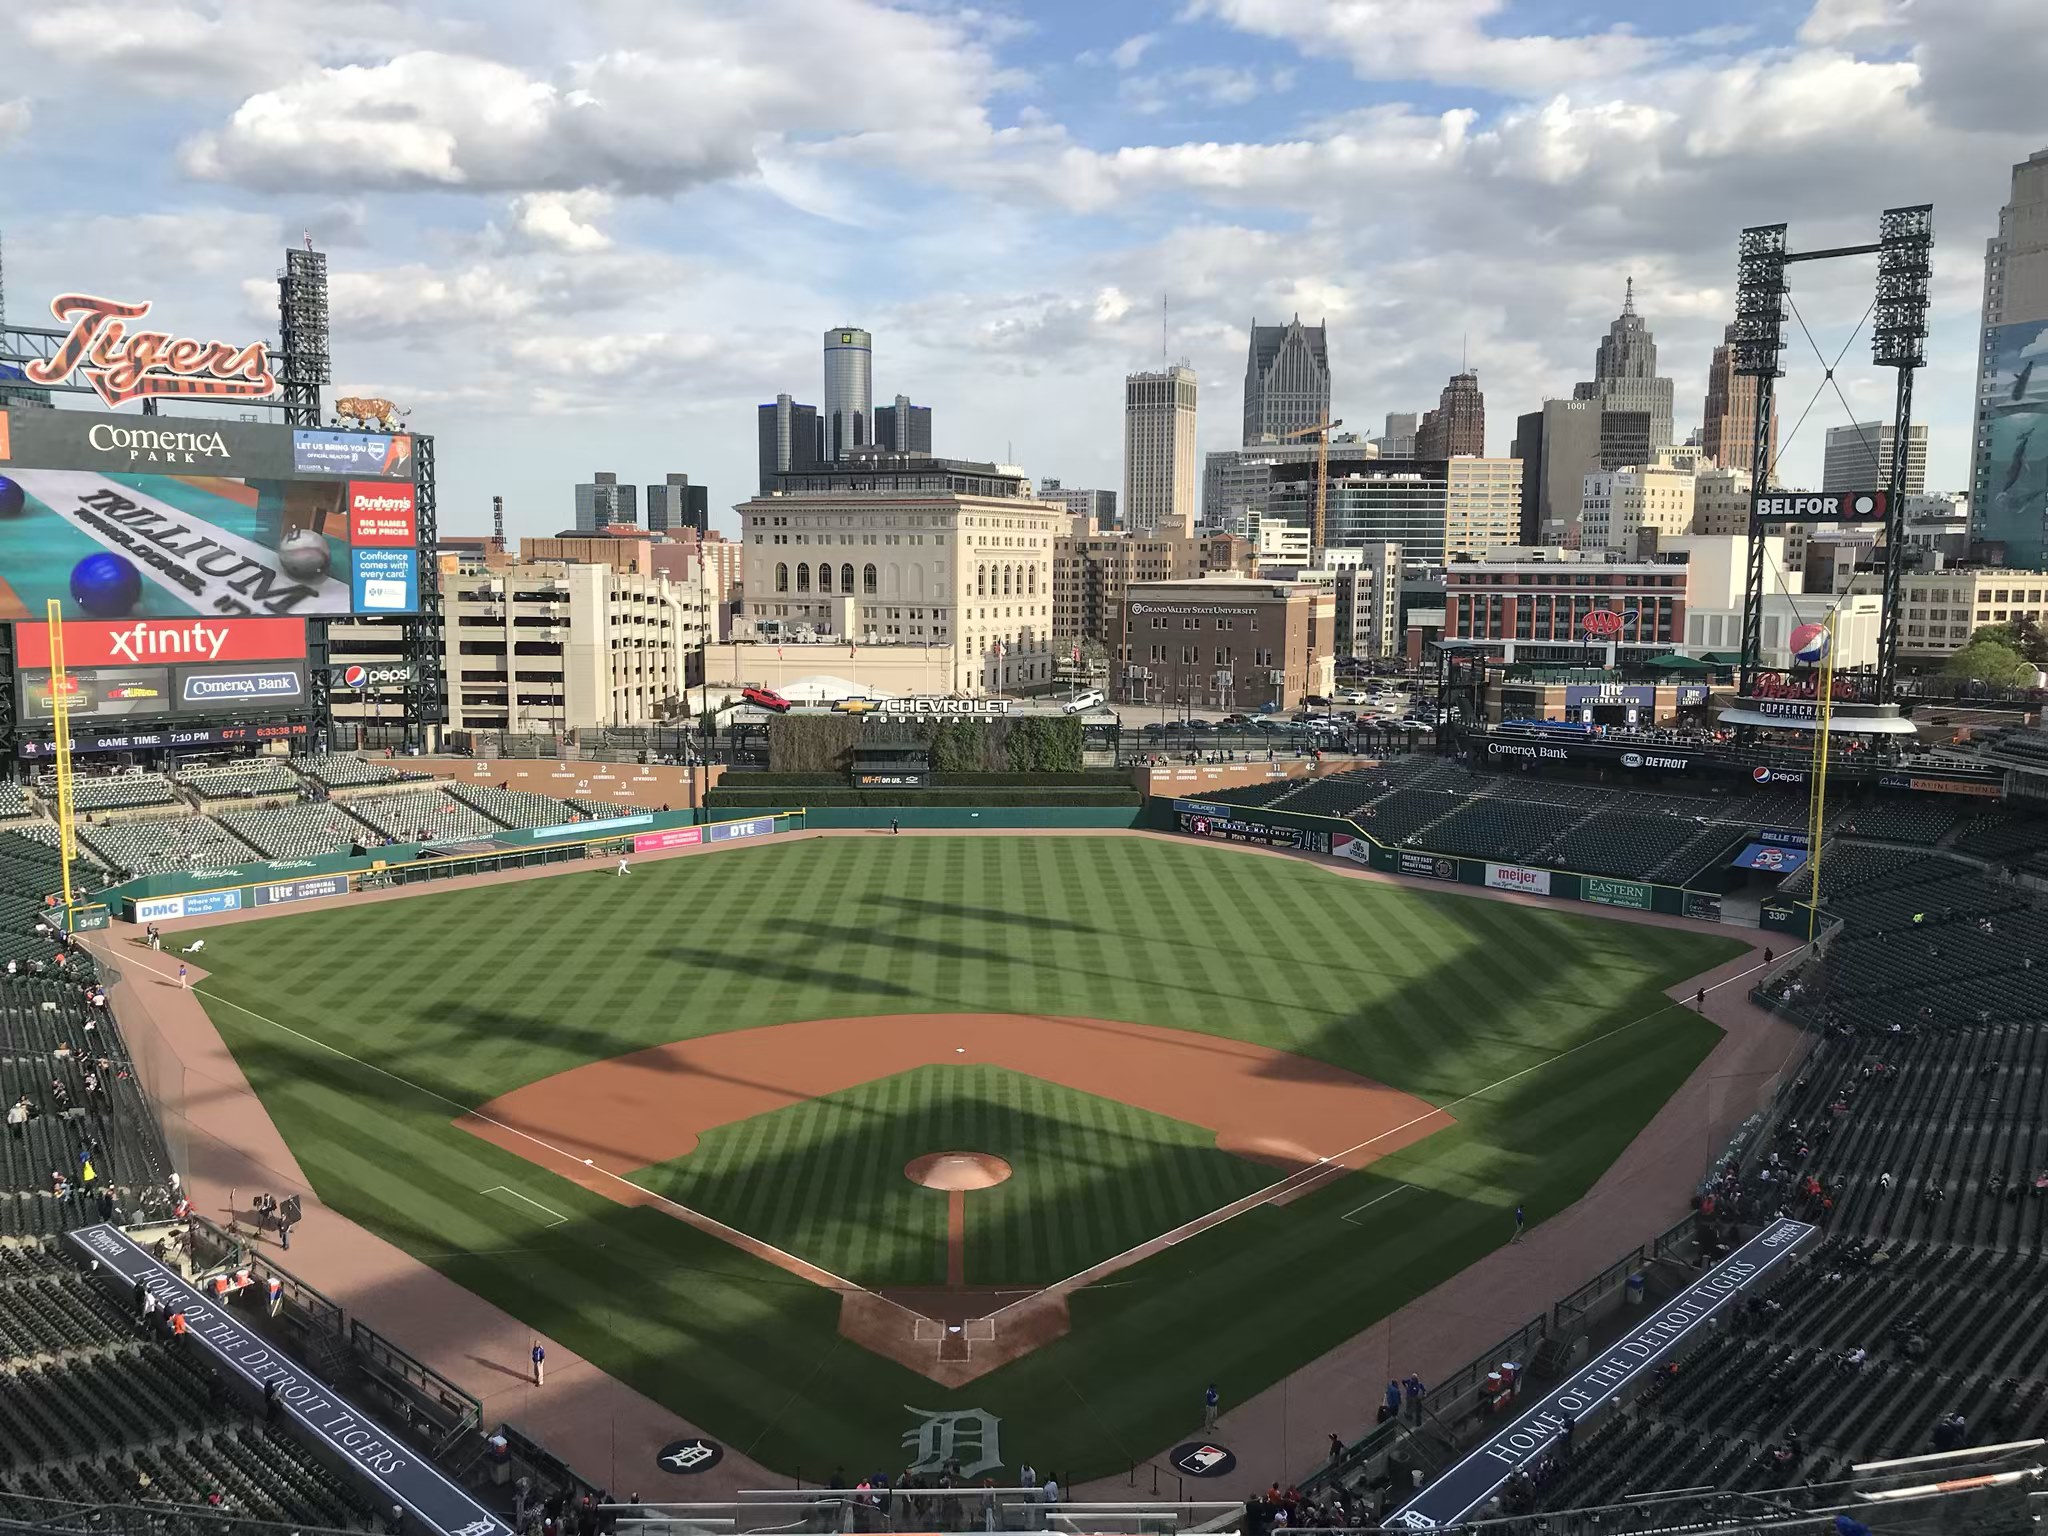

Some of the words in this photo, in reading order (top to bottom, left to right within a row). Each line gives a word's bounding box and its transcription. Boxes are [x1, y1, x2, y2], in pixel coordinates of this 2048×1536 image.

[25, 293, 275, 409] Tigers
[130, 450, 195, 463] PARK
[354, 495, 411, 510] Dunham's
[1757, 497, 1838, 515] BELFOR
[377, 520, 407, 528] NAMES
[379, 528, 409, 536] PRICES
[78, 488, 319, 614] TRILLIUM
[360, 551, 408, 560] Confidence
[390, 561, 408, 569] with
[360, 571, 384, 580] every
[1142, 605, 1167, 613] GRAND
[1167, 606, 1191, 614] VALLEY
[1586, 611, 1621, 632] AAA
[109, 621, 230, 661] xfinity
[369, 667, 410, 684] pepsi
[258, 678, 291, 690] Bank
[1600, 683, 1624, 698] Lite
[886, 699, 1013, 714] CHEVROLET
[862, 716, 993, 724] FOUNTAIN
[98, 738, 128, 747] GAME
[133, 736, 160, 745] TIME:
[170, 734, 191, 742] 7:10
[194, 732, 209, 741] PM
[257, 727, 290, 737] 6:33:38
[292, 725, 306, 734] PM
[1540, 747, 1568, 760] Bank
[560, 763, 566, 771] 5
[1305, 763, 1315, 771] 42
[1645, 757, 1688, 769] DETROIT
[862, 776, 881, 784] Wi-Fi
[1772, 772, 1803, 784] pepsi
[730, 823, 755, 837] DTE
[421, 834, 493, 847] MotorCityCasino.com
[1762, 833, 1789, 842] BELLE
[1791, 835, 1811, 844] TIRE
[1498, 868, 1536, 884] meijer
[269, 886, 293, 901] Lite
[1589, 879, 1643, 897] EASTERN
[141, 903, 178, 917] DMC
[1769, 912, 1787, 921] 330'
[1486, 1409, 1565, 1465] HOME
[1557, 1386, 1588, 1410] OF
[1585, 1355, 1633, 1390] THE
[1621, 1299, 1704, 1359] DETROIT
[1692, 1260, 1756, 1302] TIGERS
[184, 1305, 215, 1327] OF
[204, 1322, 248, 1352] THE
[240, 1349, 331, 1416] DETROIT
[324, 1411, 405, 1475] TIGERS
